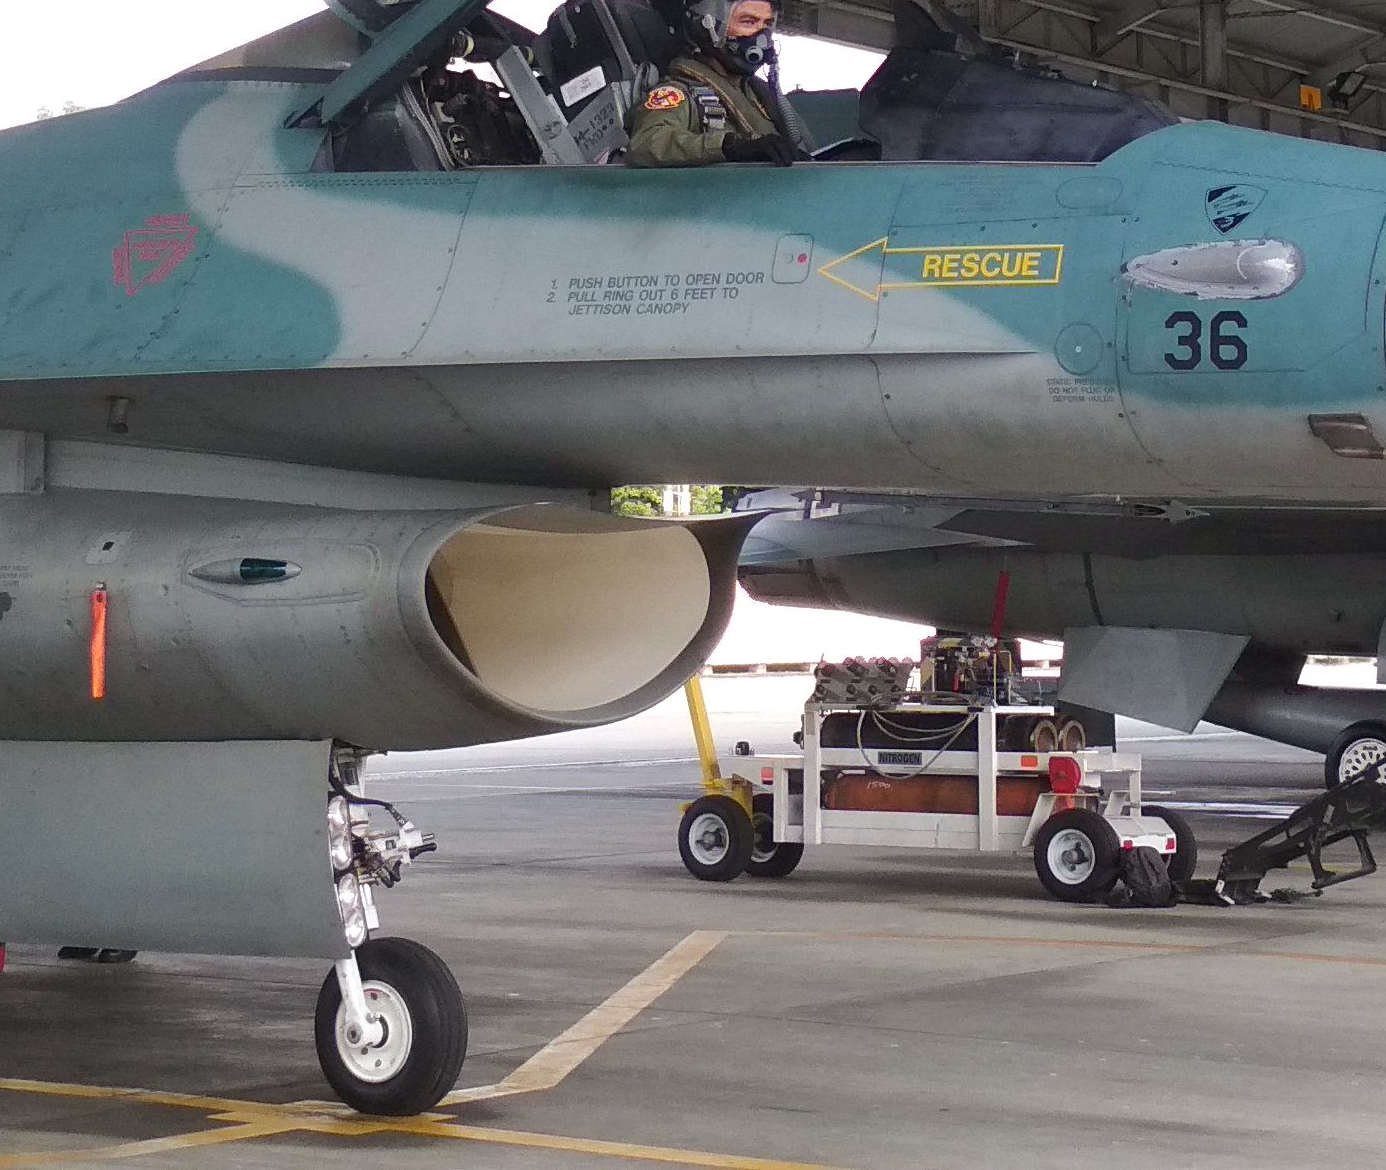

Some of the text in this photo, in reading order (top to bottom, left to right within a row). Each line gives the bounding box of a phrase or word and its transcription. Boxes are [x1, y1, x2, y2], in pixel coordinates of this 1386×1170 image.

[922, 252, 1041, 279] RESCUE
[568, 278, 603, 289] PUSH
[607, 276, 659, 288] BUTTON
[663, 274, 681, 287] TO
[685, 273, 721, 286] OPEN
[725, 272, 765, 284] DOOR
[567, 291, 598, 303] PULL
[603, 290, 634, 302] RING
[638, 289, 664, 301] OUT
[670, 289, 679, 300] 6
[683, 288, 717, 300] FEET
[722, 287, 740, 299] TO
[567, 303, 691, 316] JETTISON CANOPY
[1163, 310, 1248, 371] 36
[878, 752, 921, 765] NITROGEN
